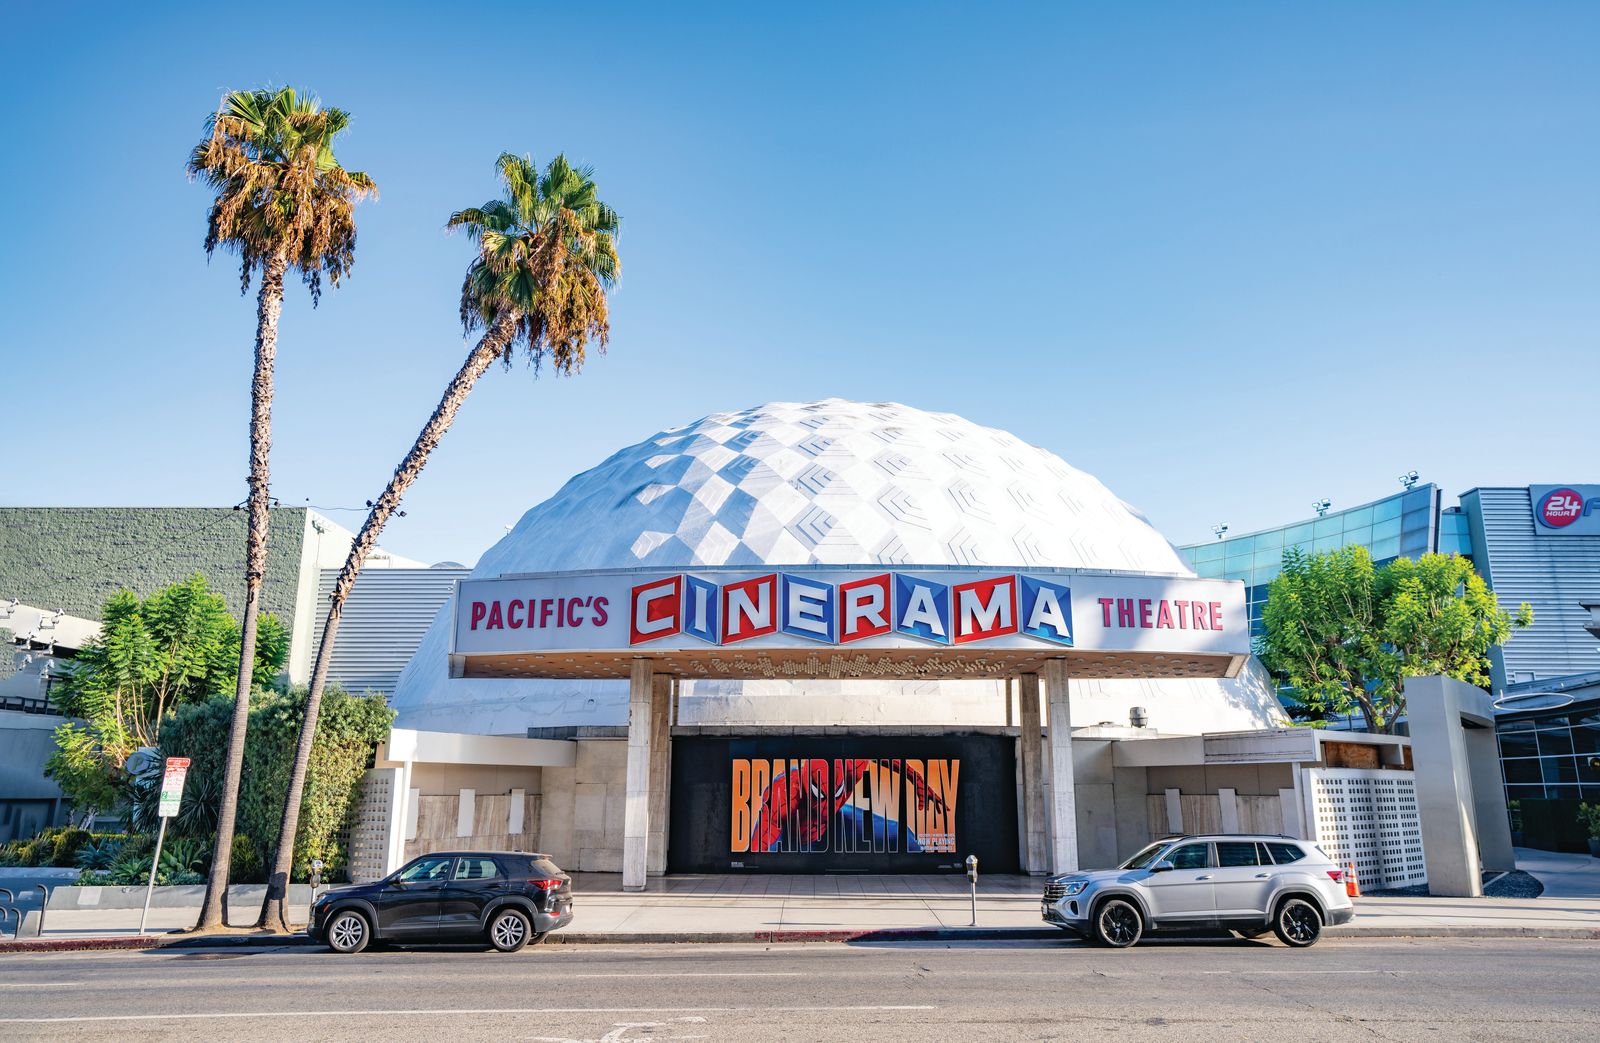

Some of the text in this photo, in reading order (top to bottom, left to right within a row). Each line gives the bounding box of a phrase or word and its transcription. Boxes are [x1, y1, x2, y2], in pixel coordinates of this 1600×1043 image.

[1547, 496, 1581, 516] 24
[470, 581, 1224, 639] PACIFIC'S CINERAMA THEATRE
[731, 759, 960, 853] BRAND NEW DAY
[918, 837, 955, 846] NOW PLAYING
